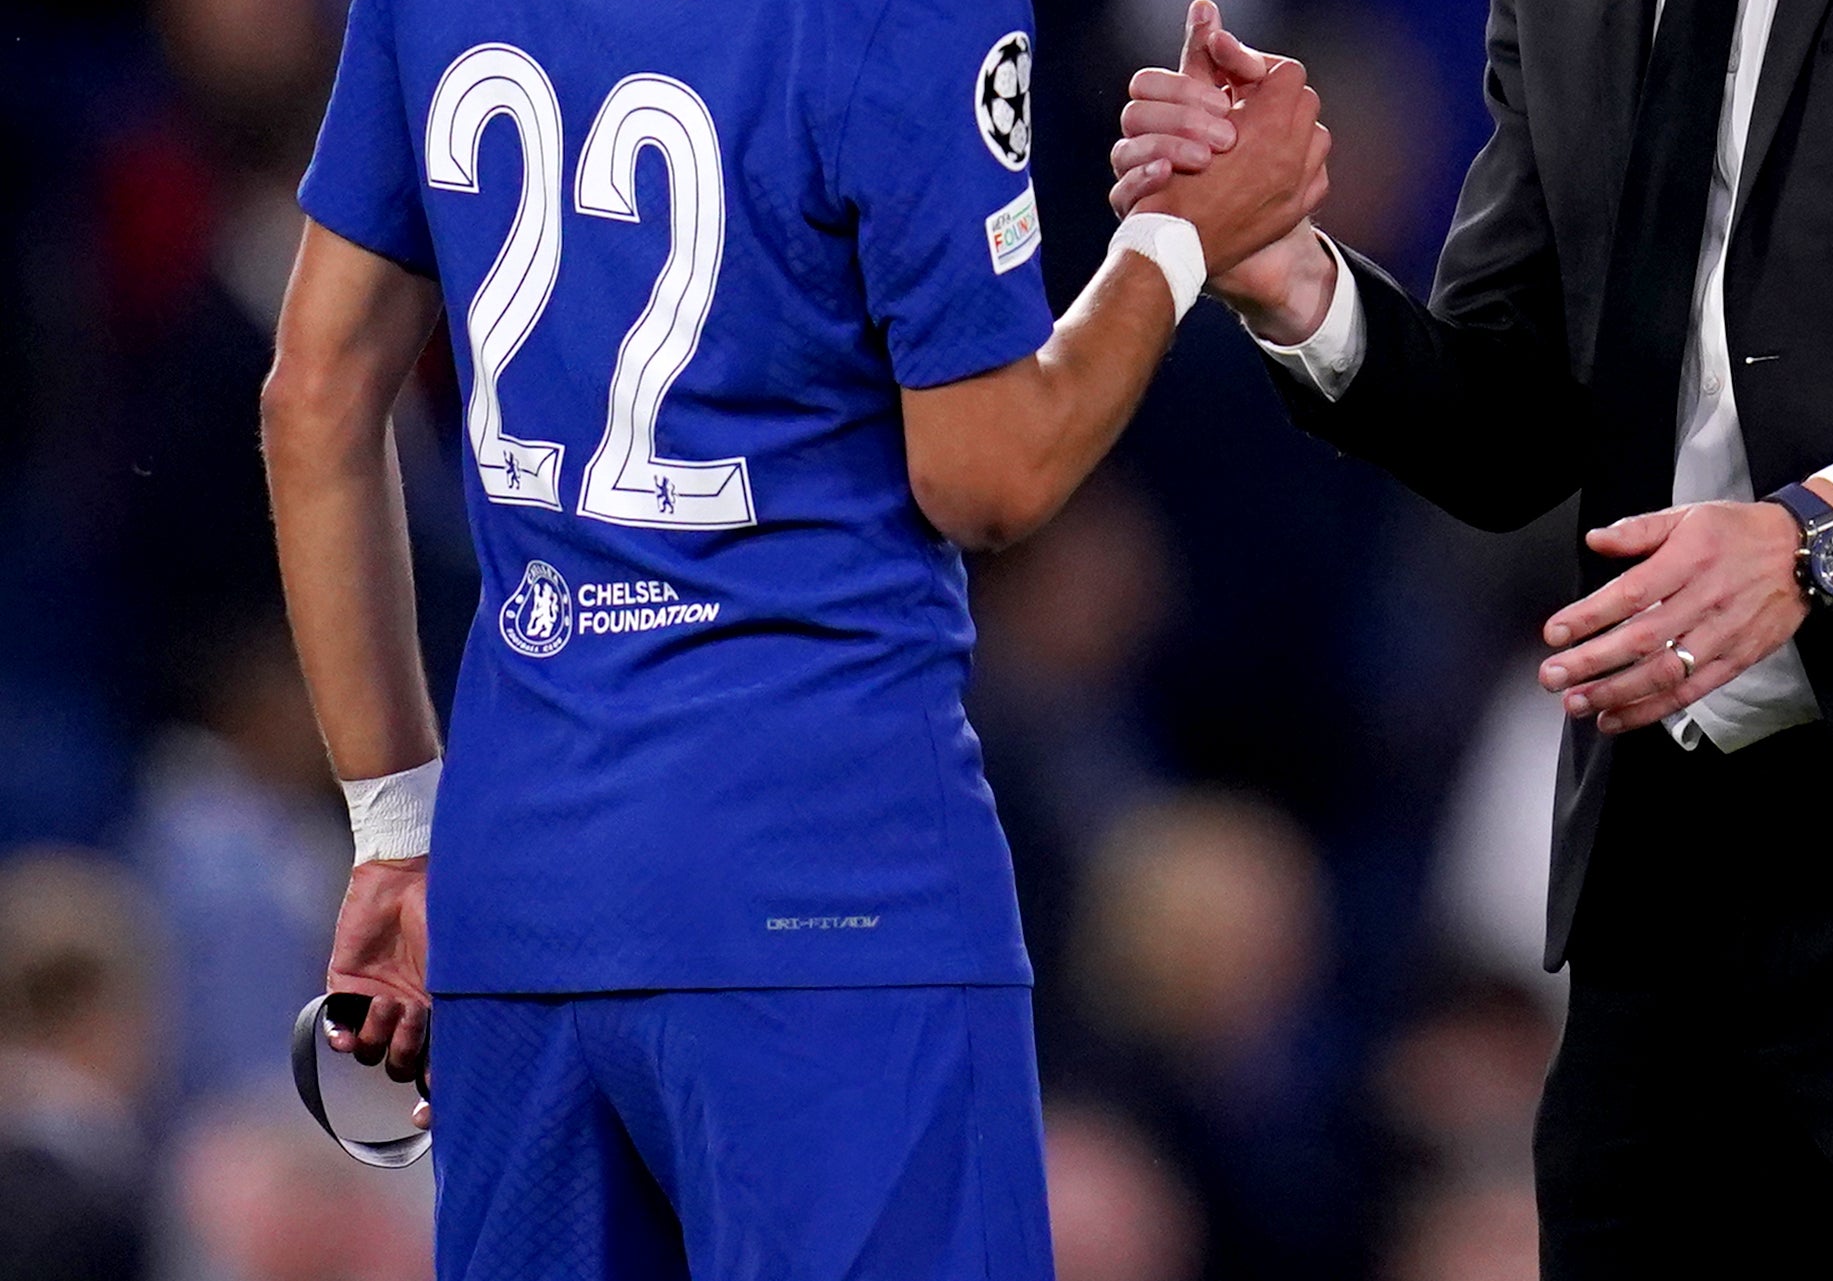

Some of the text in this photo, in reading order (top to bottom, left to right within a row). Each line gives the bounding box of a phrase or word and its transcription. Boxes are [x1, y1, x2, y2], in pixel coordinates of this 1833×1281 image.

[425, 42, 758, 531] 22
[578, 581, 680, 607] CHELSEA
[578, 602, 720, 635] FOUNDATION
